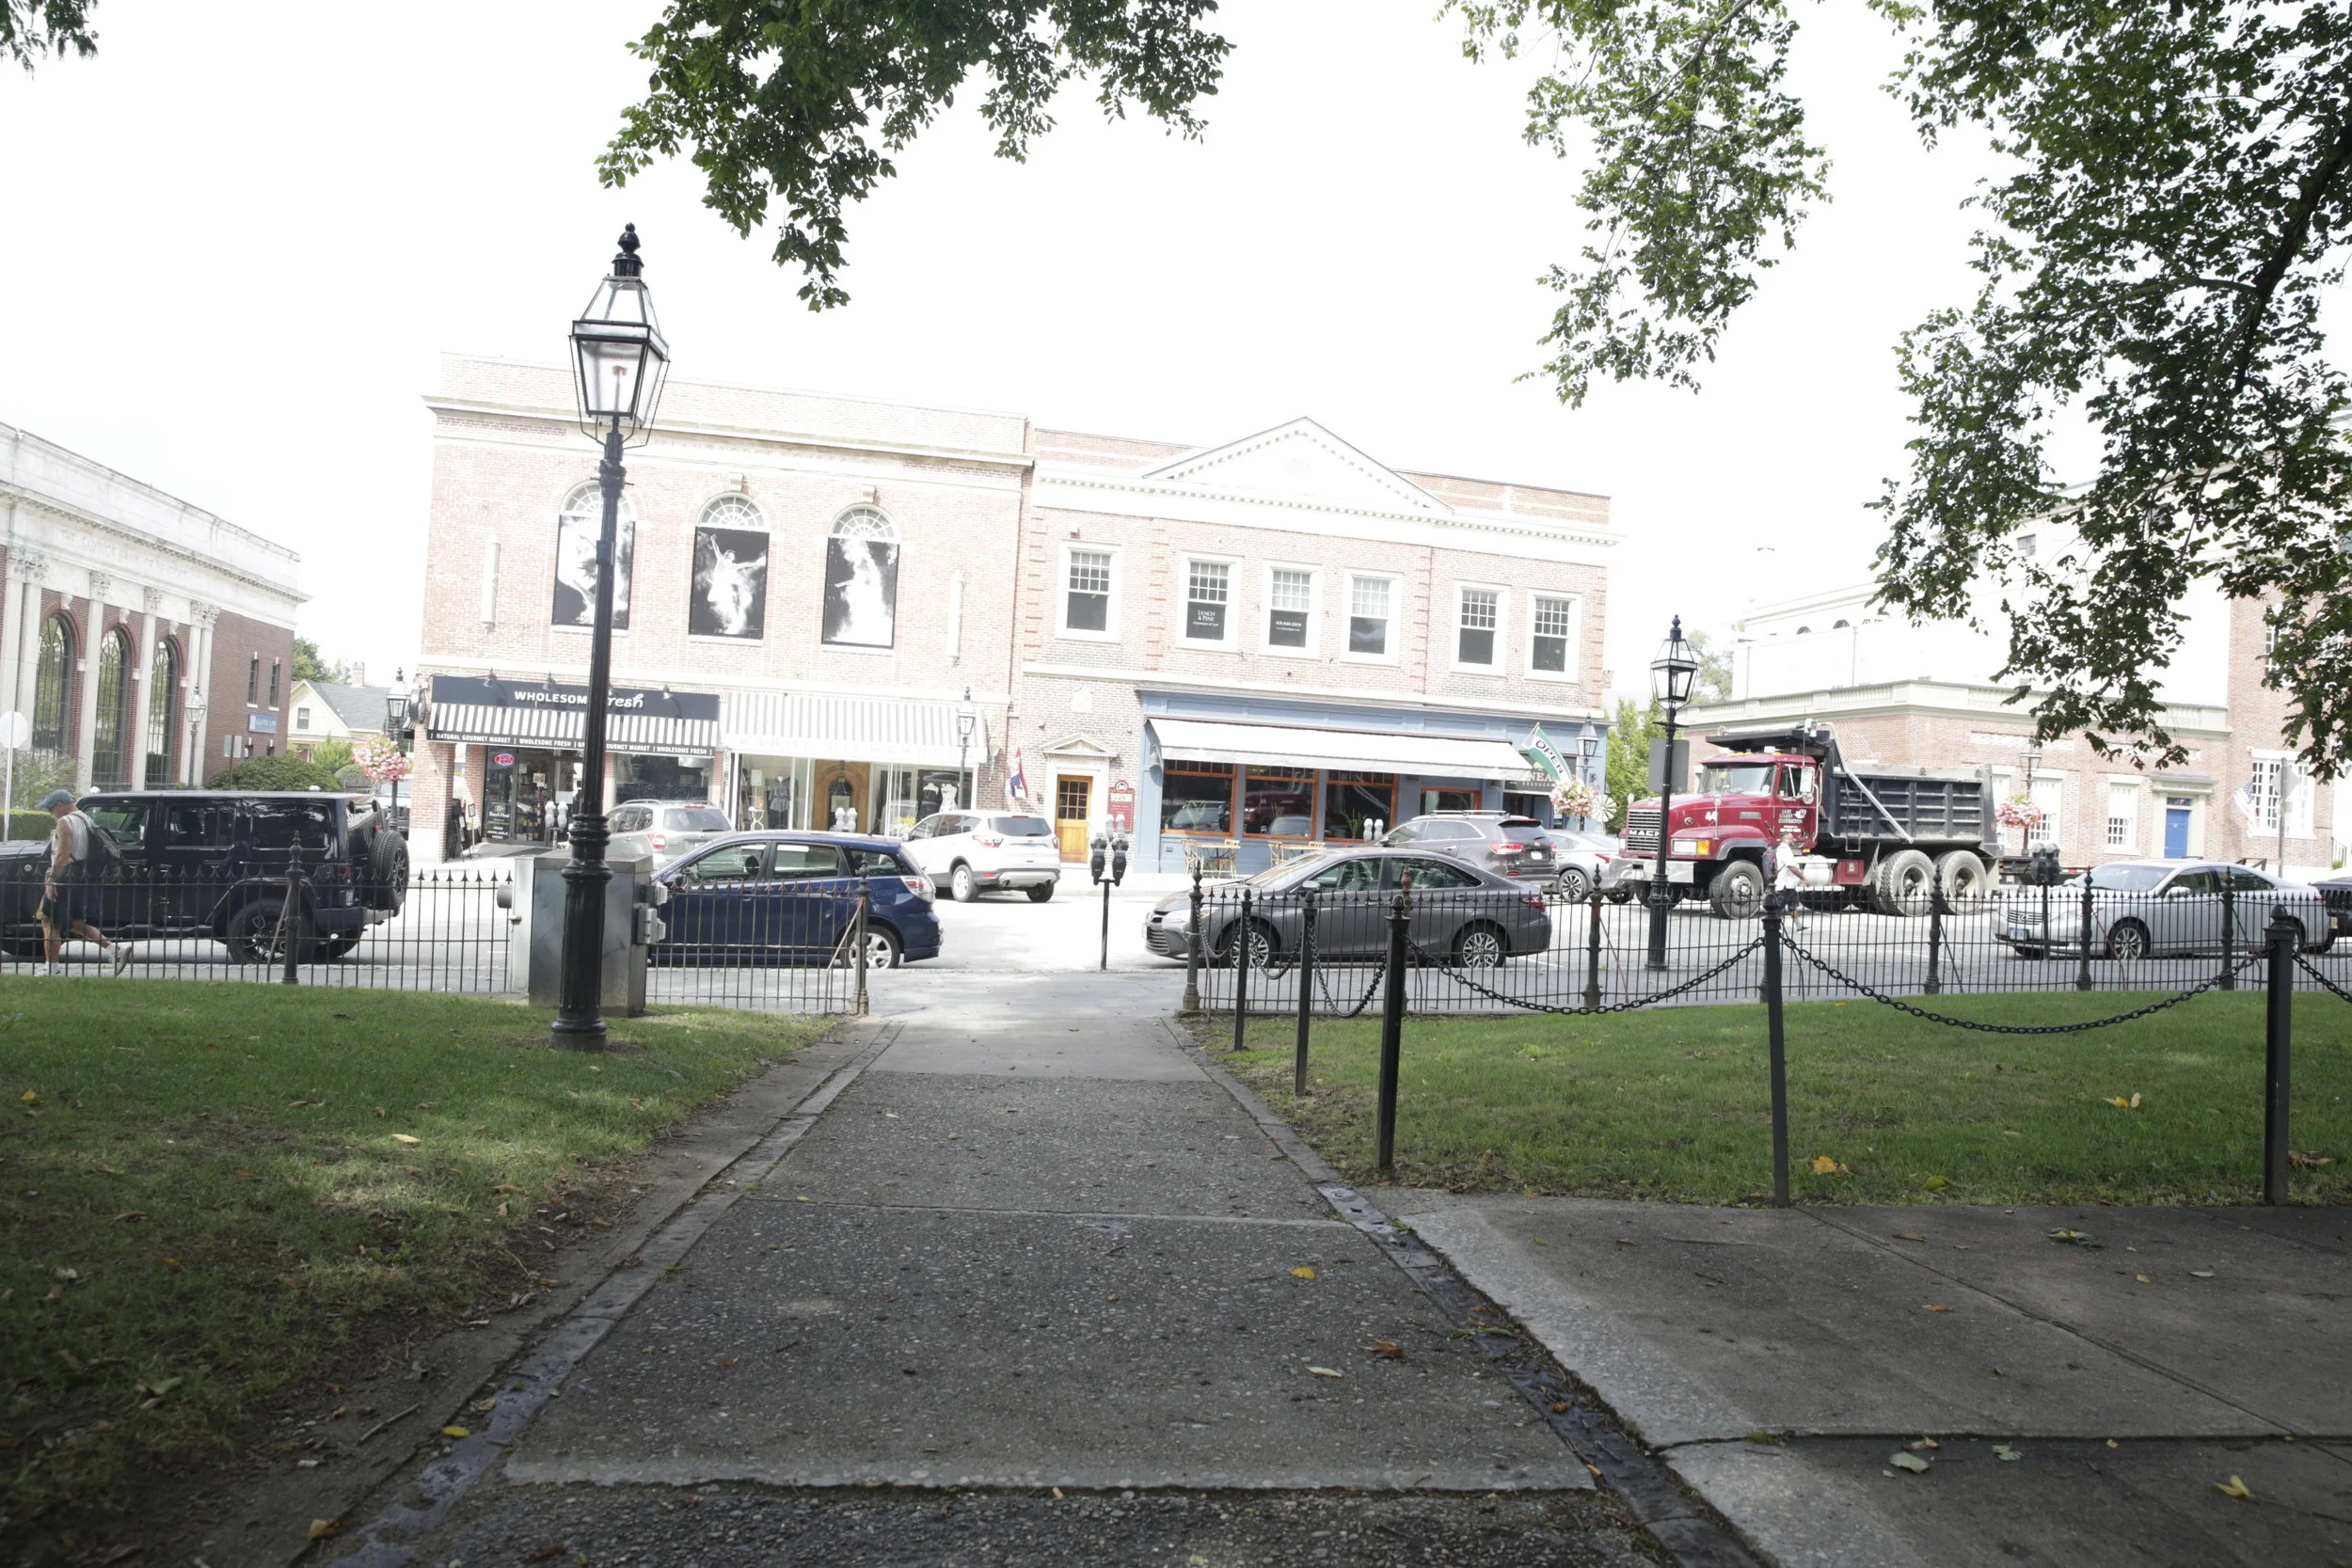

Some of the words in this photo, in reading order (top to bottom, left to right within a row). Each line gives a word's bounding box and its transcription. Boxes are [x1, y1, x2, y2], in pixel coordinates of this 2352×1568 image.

[515, 690, 588, 705] WHOLESOM
[607, 693, 644, 708] resh
[462, 734, 488, 742] GOURMET
[489, 736, 511, 744] MARKET
[553, 739, 571, 748] FRESH
[1535, 739, 1564, 774] OPEN
